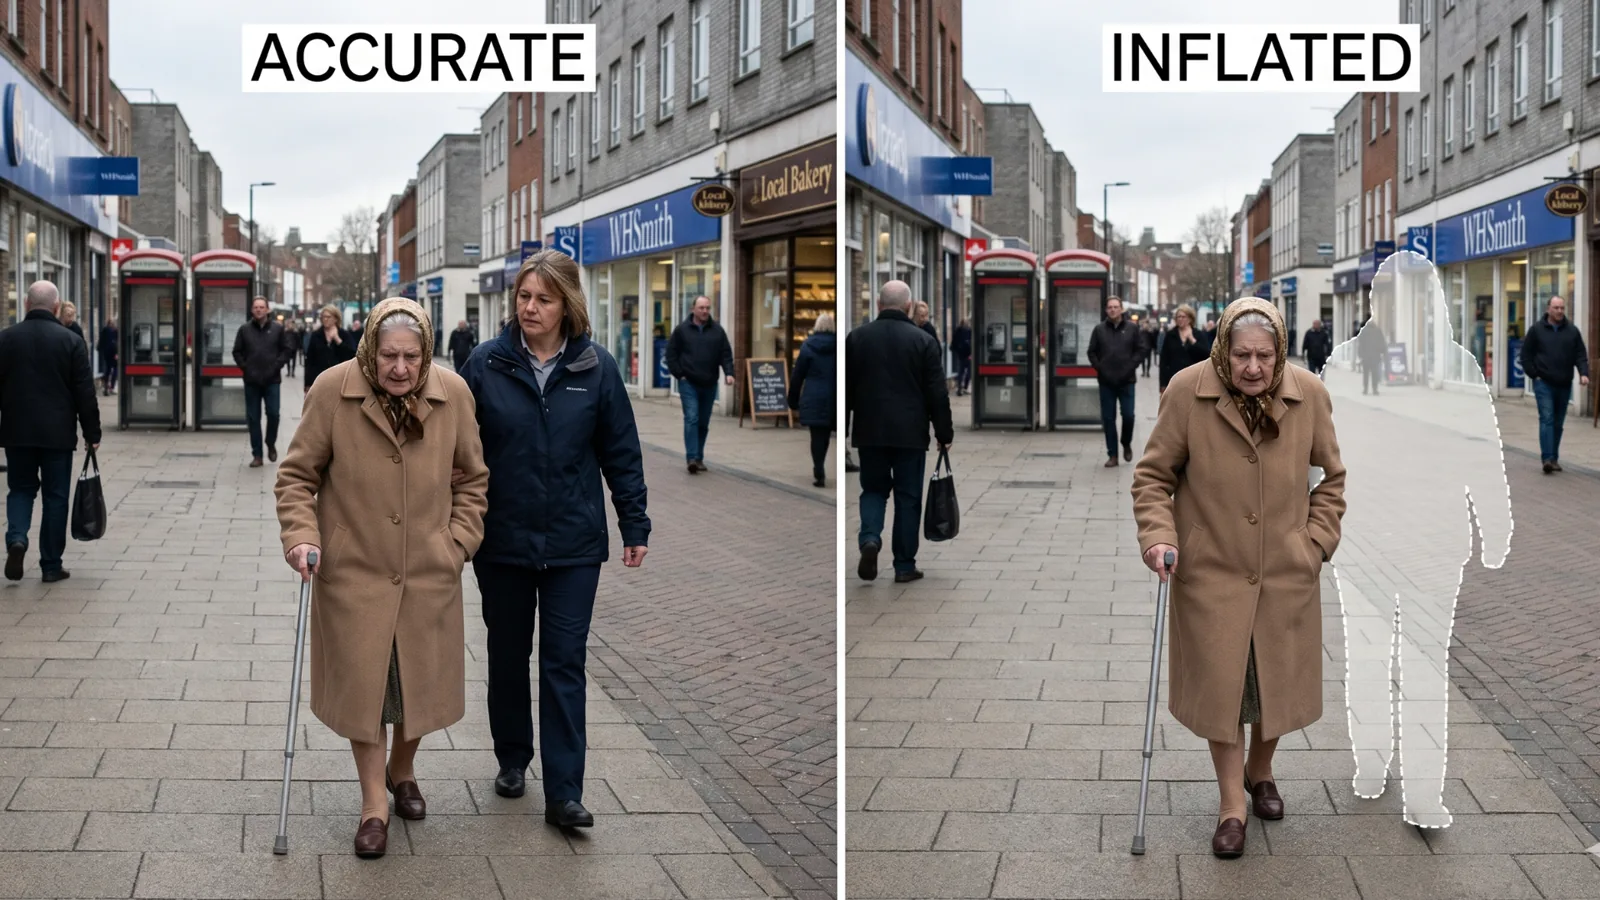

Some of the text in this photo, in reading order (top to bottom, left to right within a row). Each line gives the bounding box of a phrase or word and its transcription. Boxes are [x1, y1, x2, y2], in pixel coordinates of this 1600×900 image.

[760, 160, 833, 202] Local Bakery
[702, 190, 726, 200] Local
[1555, 190, 1579, 200] Local
[559, 227, 576, 237] WH
[609, 200, 674, 257] WHSmith
[1411, 227, 1429, 236] WH
[1462, 200, 1527, 257] WHSmith
[559, 235, 576, 259] S
[1412, 235, 1429, 260] S
